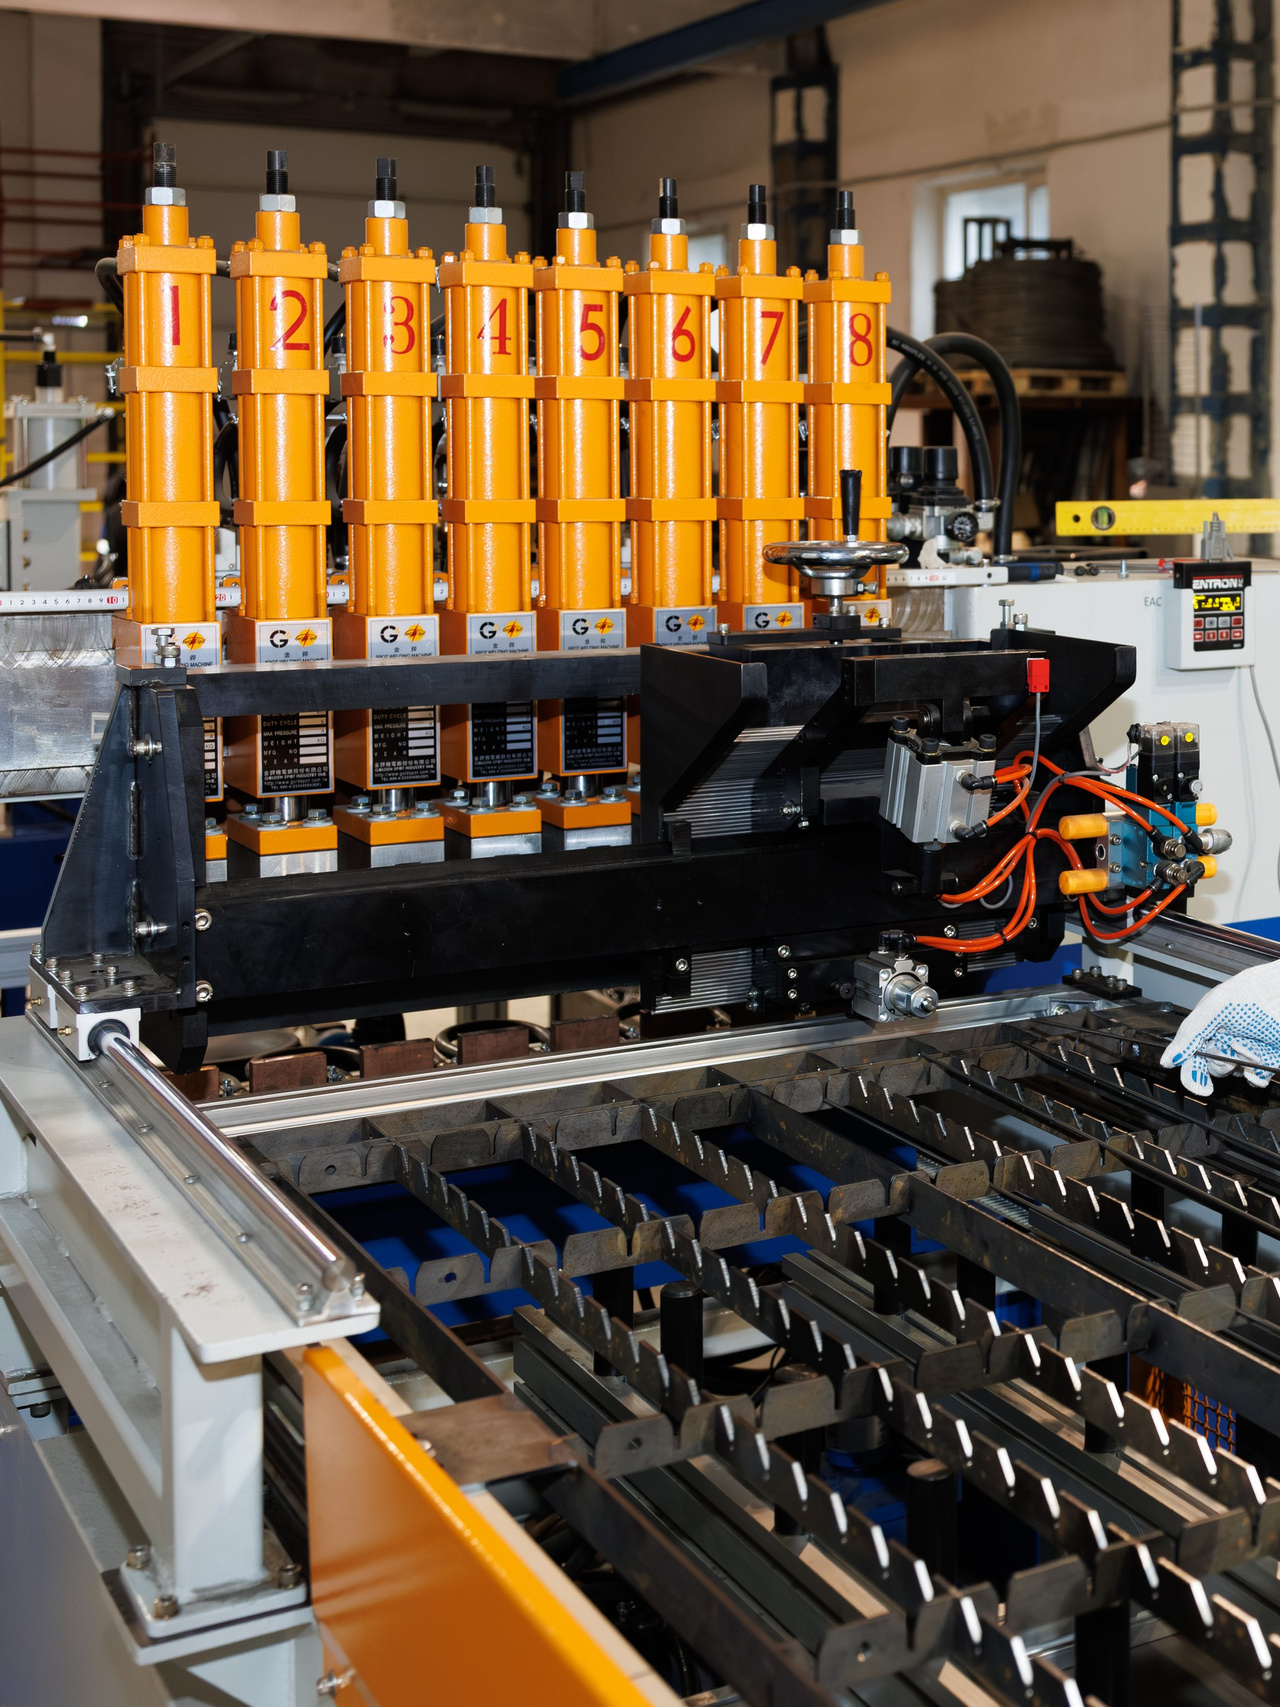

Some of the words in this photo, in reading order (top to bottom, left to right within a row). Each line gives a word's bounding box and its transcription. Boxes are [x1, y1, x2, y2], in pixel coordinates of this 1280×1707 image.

[166, 286, 180, 346] 1
[269, 289, 311, 351] 2
[383, 296, 415, 354] 3
[477, 298, 512, 356] 4
[580, 304, 605, 361] 5
[671, 306, 696, 362] 6
[761, 311, 784, 366] 7
[849, 313, 873, 366] 8
[1144, 597, 1163, 607] EAC
[1192, 578, 1237, 590] ENTRON
